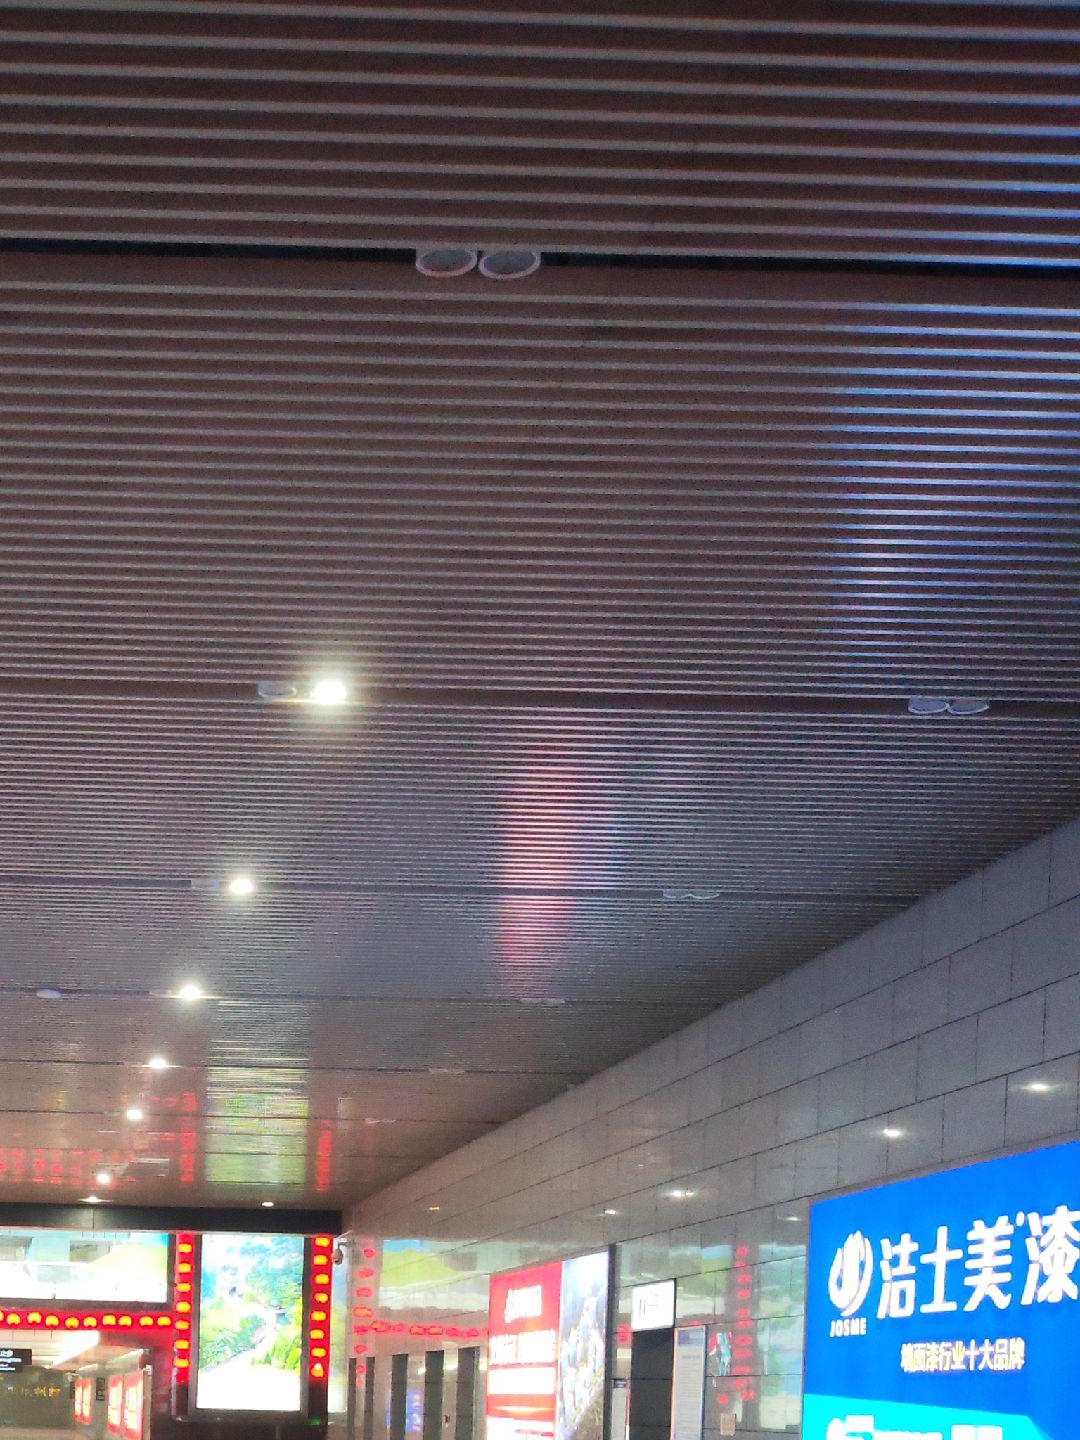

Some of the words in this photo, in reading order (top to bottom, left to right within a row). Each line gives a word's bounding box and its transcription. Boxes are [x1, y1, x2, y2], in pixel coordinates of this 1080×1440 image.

[829, 1318, 867, 1337] JOSME
[901, 1337, 1025, 1372] 墙面漆行业十大品牌
